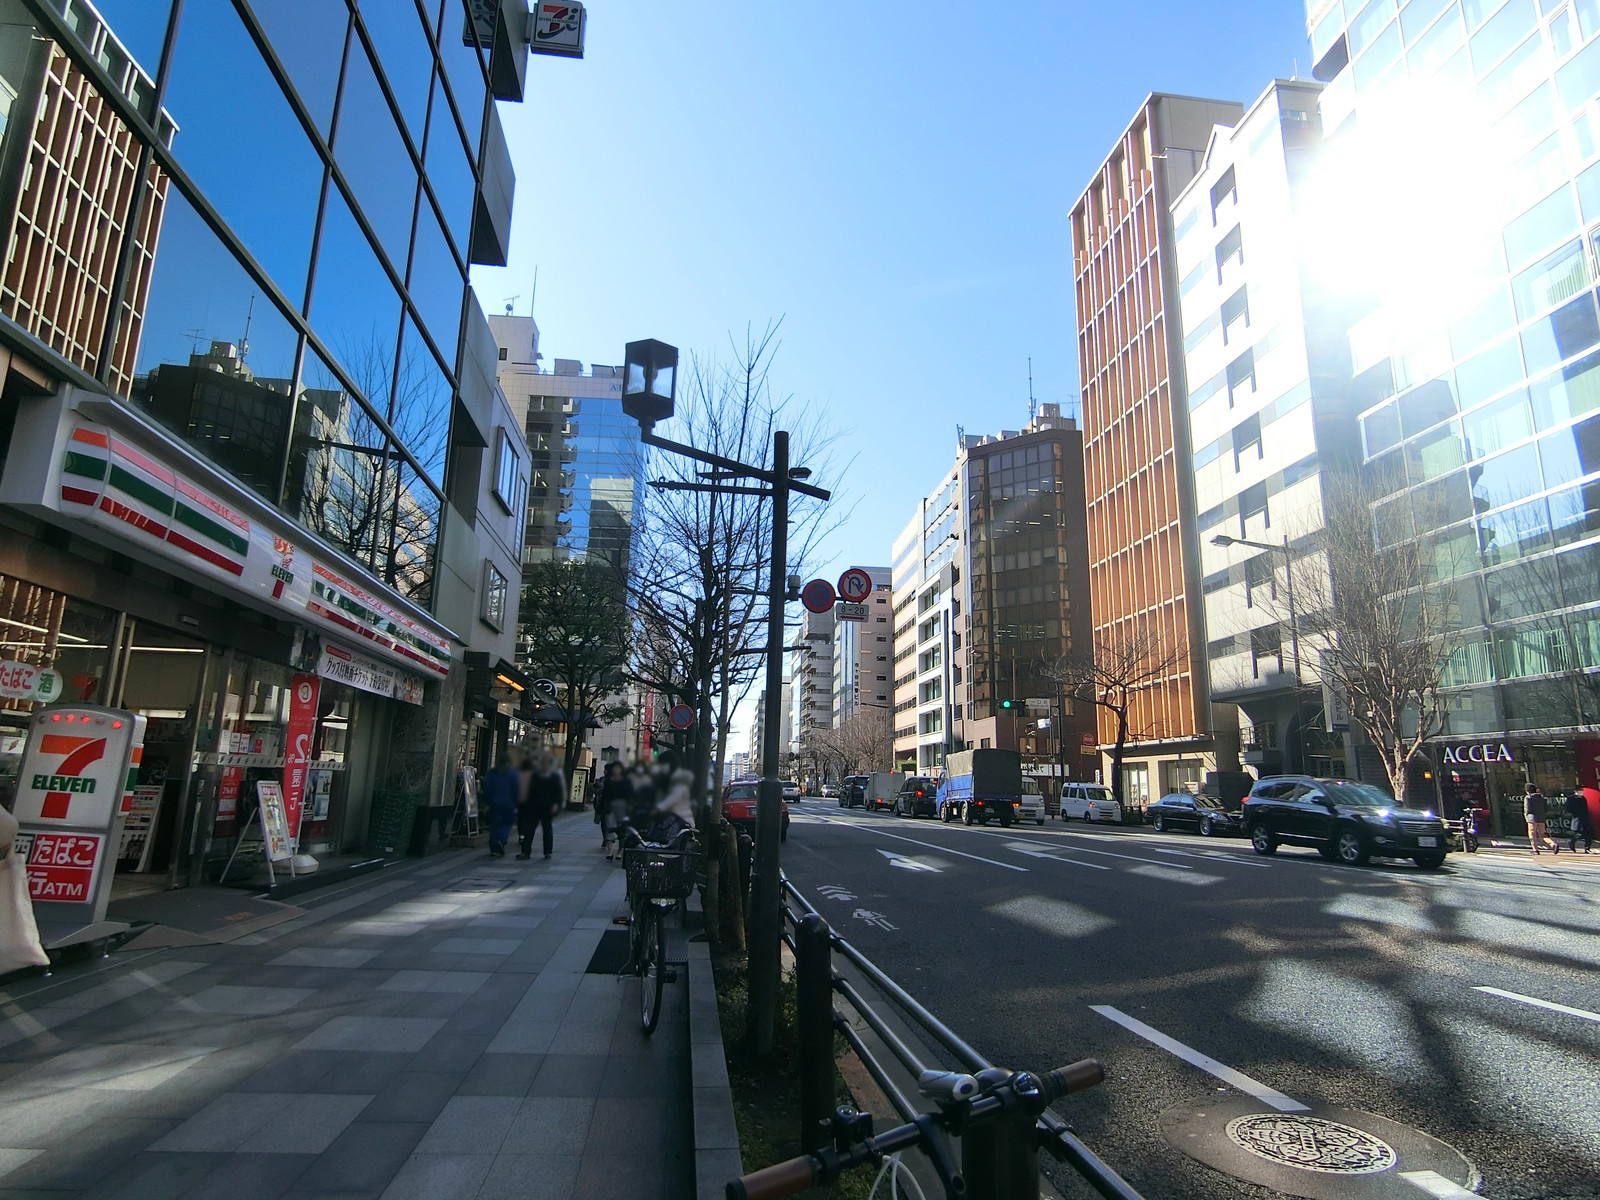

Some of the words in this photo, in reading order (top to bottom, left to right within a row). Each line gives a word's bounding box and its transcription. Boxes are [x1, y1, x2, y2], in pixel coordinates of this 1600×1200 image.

[1443, 743, 1513, 763] ACCEA
[32, 837, 95, 865] たばこ
[27, 871, 83, 896] 行ATM
